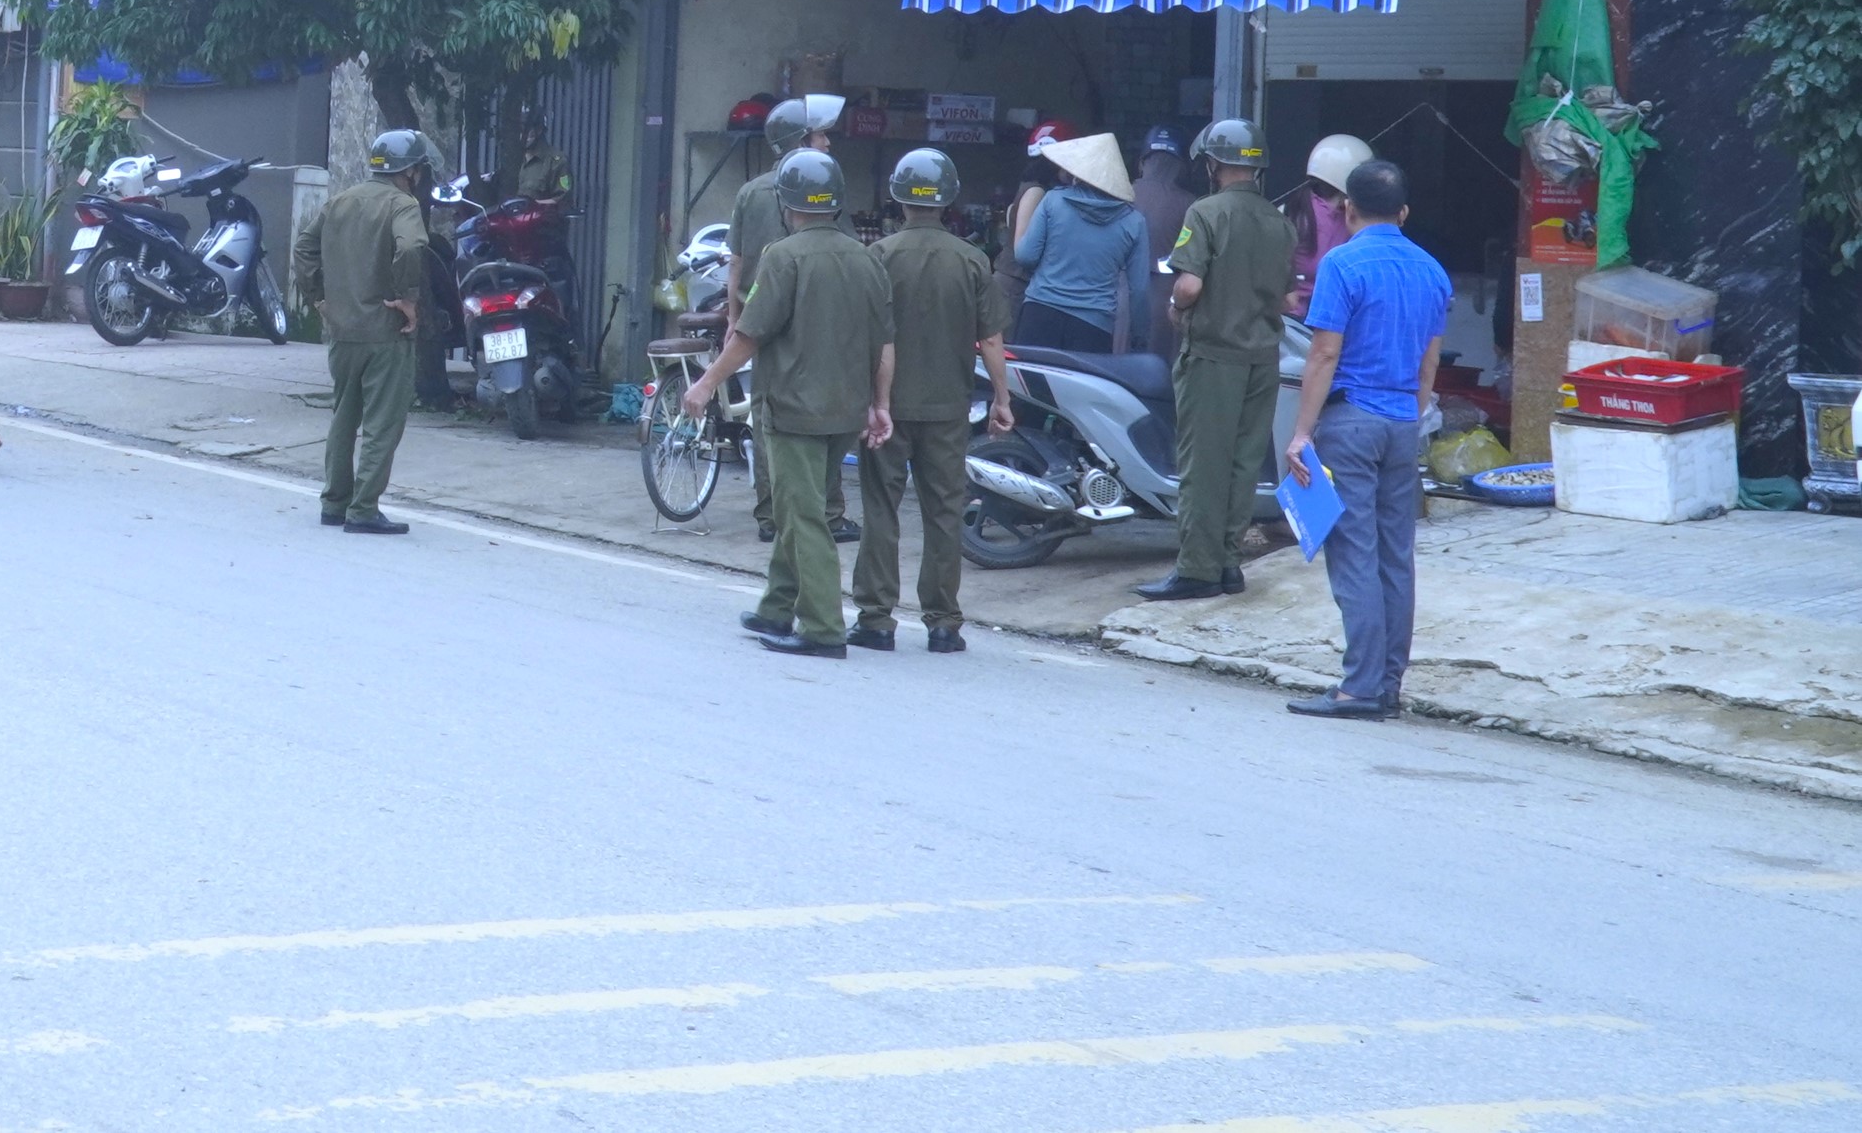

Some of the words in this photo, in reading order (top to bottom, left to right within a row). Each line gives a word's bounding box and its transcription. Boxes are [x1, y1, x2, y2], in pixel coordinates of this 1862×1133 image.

[941, 107, 979, 118] VIFON
[945, 131, 982, 142] VIFON
[488, 343, 523, 362] 262.87
[1631, 399, 1656, 415] THOA
